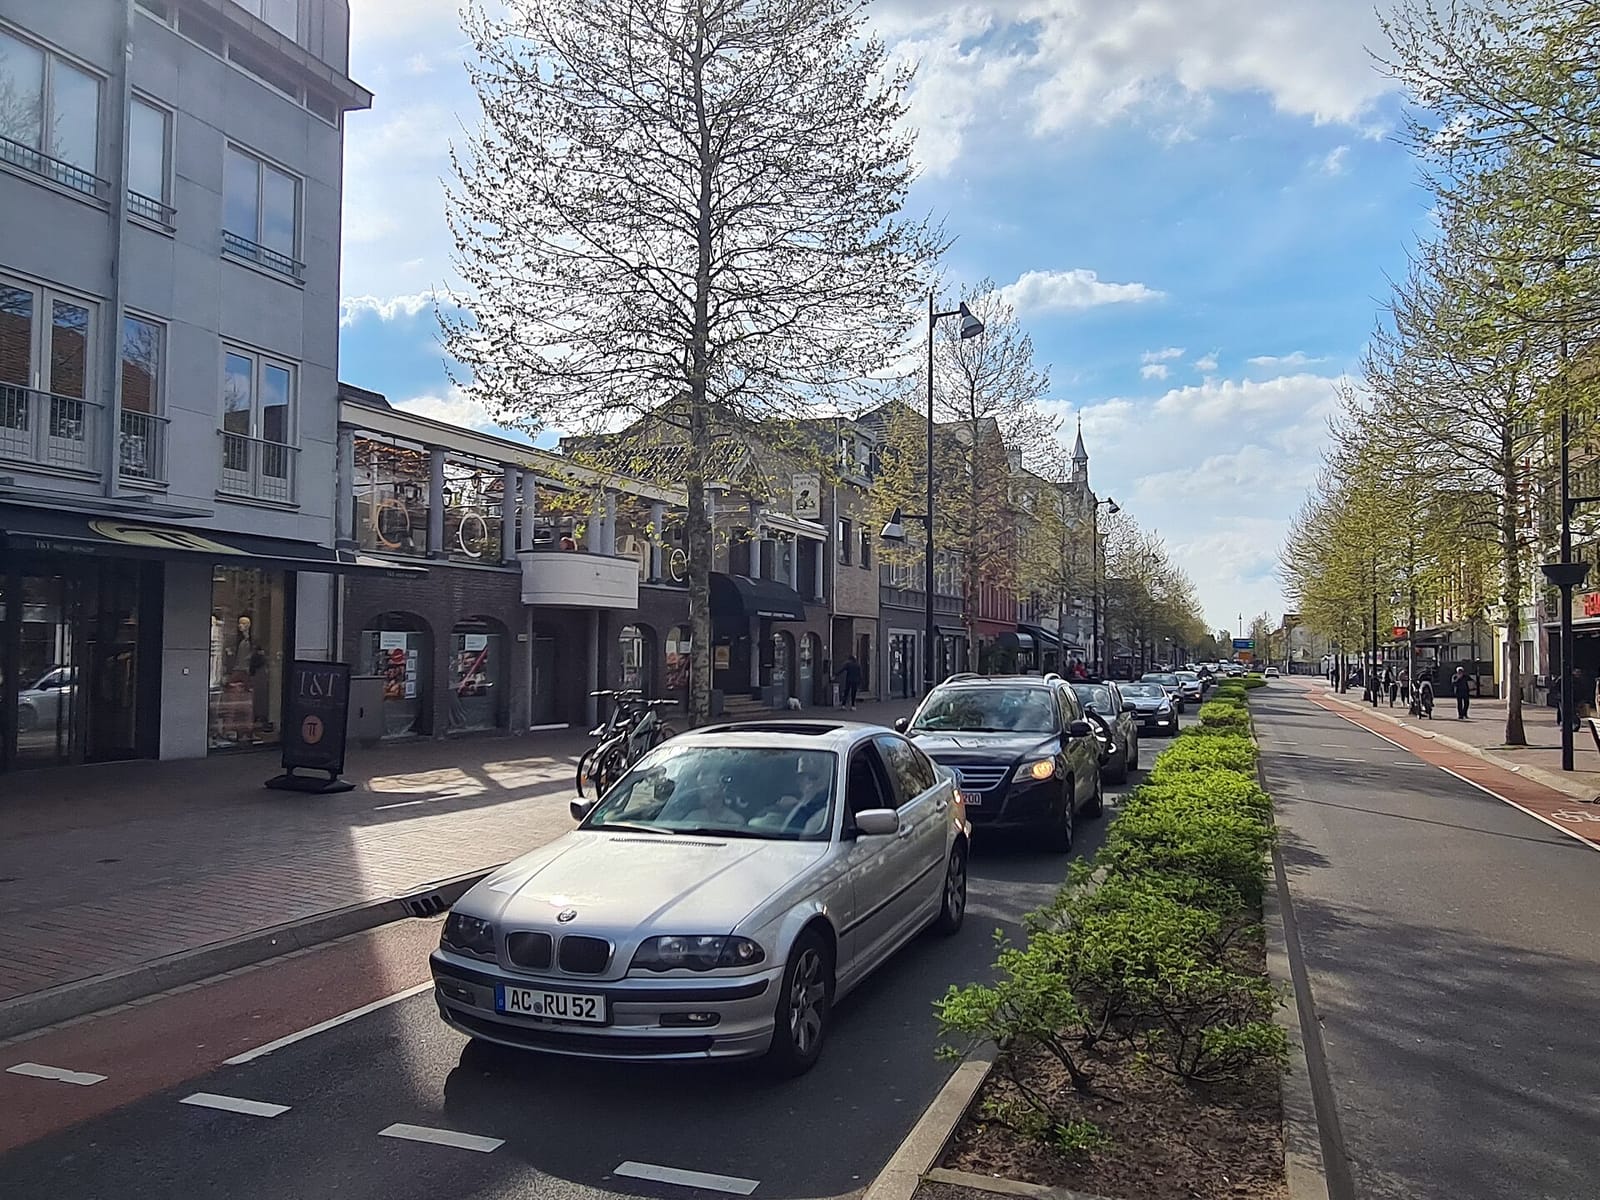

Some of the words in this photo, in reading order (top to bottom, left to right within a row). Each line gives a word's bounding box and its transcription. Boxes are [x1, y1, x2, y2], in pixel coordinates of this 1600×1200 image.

[297, 671, 340, 697] T&T
[511, 990, 532, 1011] AC
[544, 994, 567, 1016] RU
[572, 998, 596, 1018] 52
